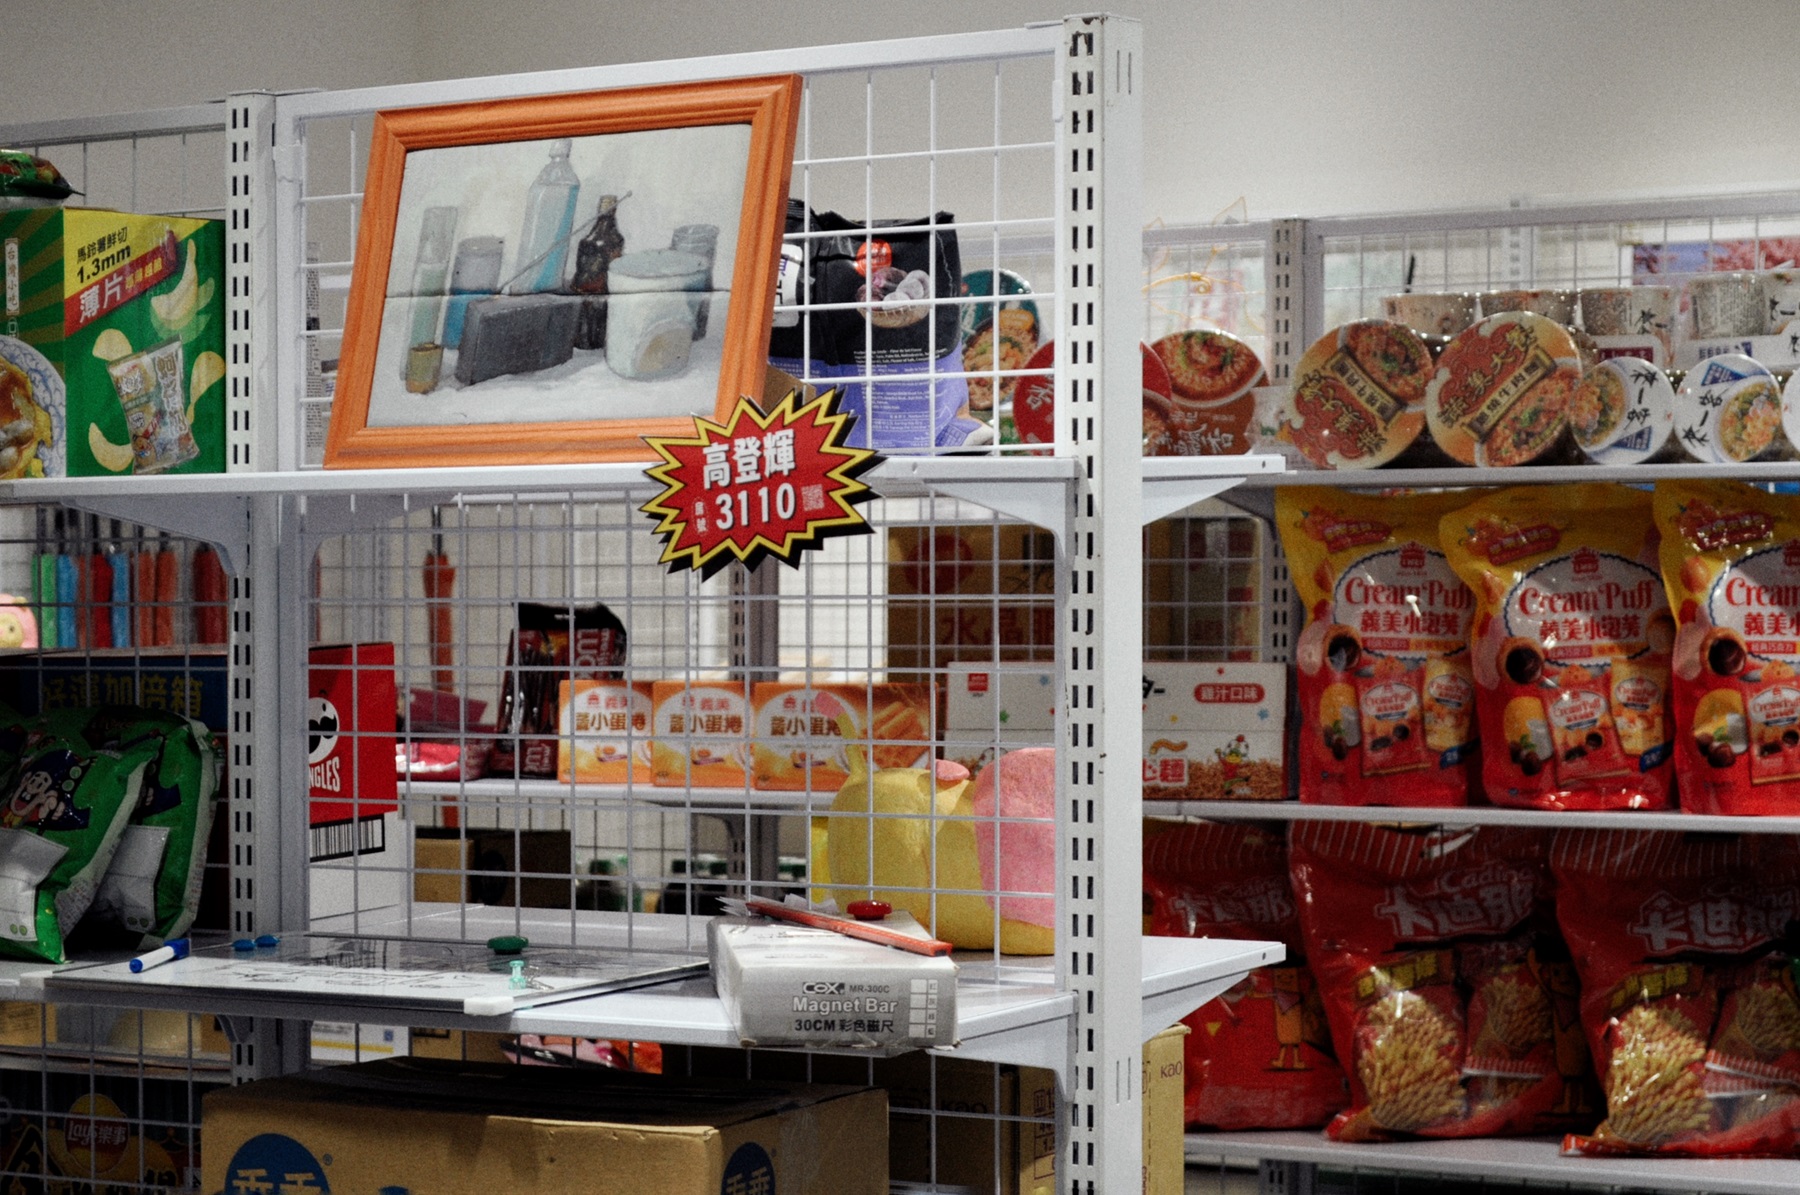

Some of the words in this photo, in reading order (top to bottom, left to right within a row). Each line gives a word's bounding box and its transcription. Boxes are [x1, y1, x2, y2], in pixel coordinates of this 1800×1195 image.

[77, 226, 129, 263] 馬鈴薯鮮切
[77, 245, 131, 283] 1.3mm
[79, 273, 124, 324] 薄片
[1438, 322, 1538, 429] 滿漢大餐
[1300, 369, 1388, 457] 滿漢大餐
[702, 428, 796, 490] 高登輝
[715, 483, 796, 530] 3110
[1344, 577, 1421, 606] Cream
[1518, 586, 1598, 616] Cream
[1600, 579, 1656, 611] Puff
[1361, 610, 1460, 635] 義美小泡芙
[1540, 614, 1640, 642] 義美小泡芙
[792, 996, 861, 1016] Magnet
[865, 997, 898, 1014] Bar
[849, 985, 890, 994] MR-300C
[794, 1019, 836, 1033] 30CM
[839, 1018, 895, 1033] 彩色磁尺
